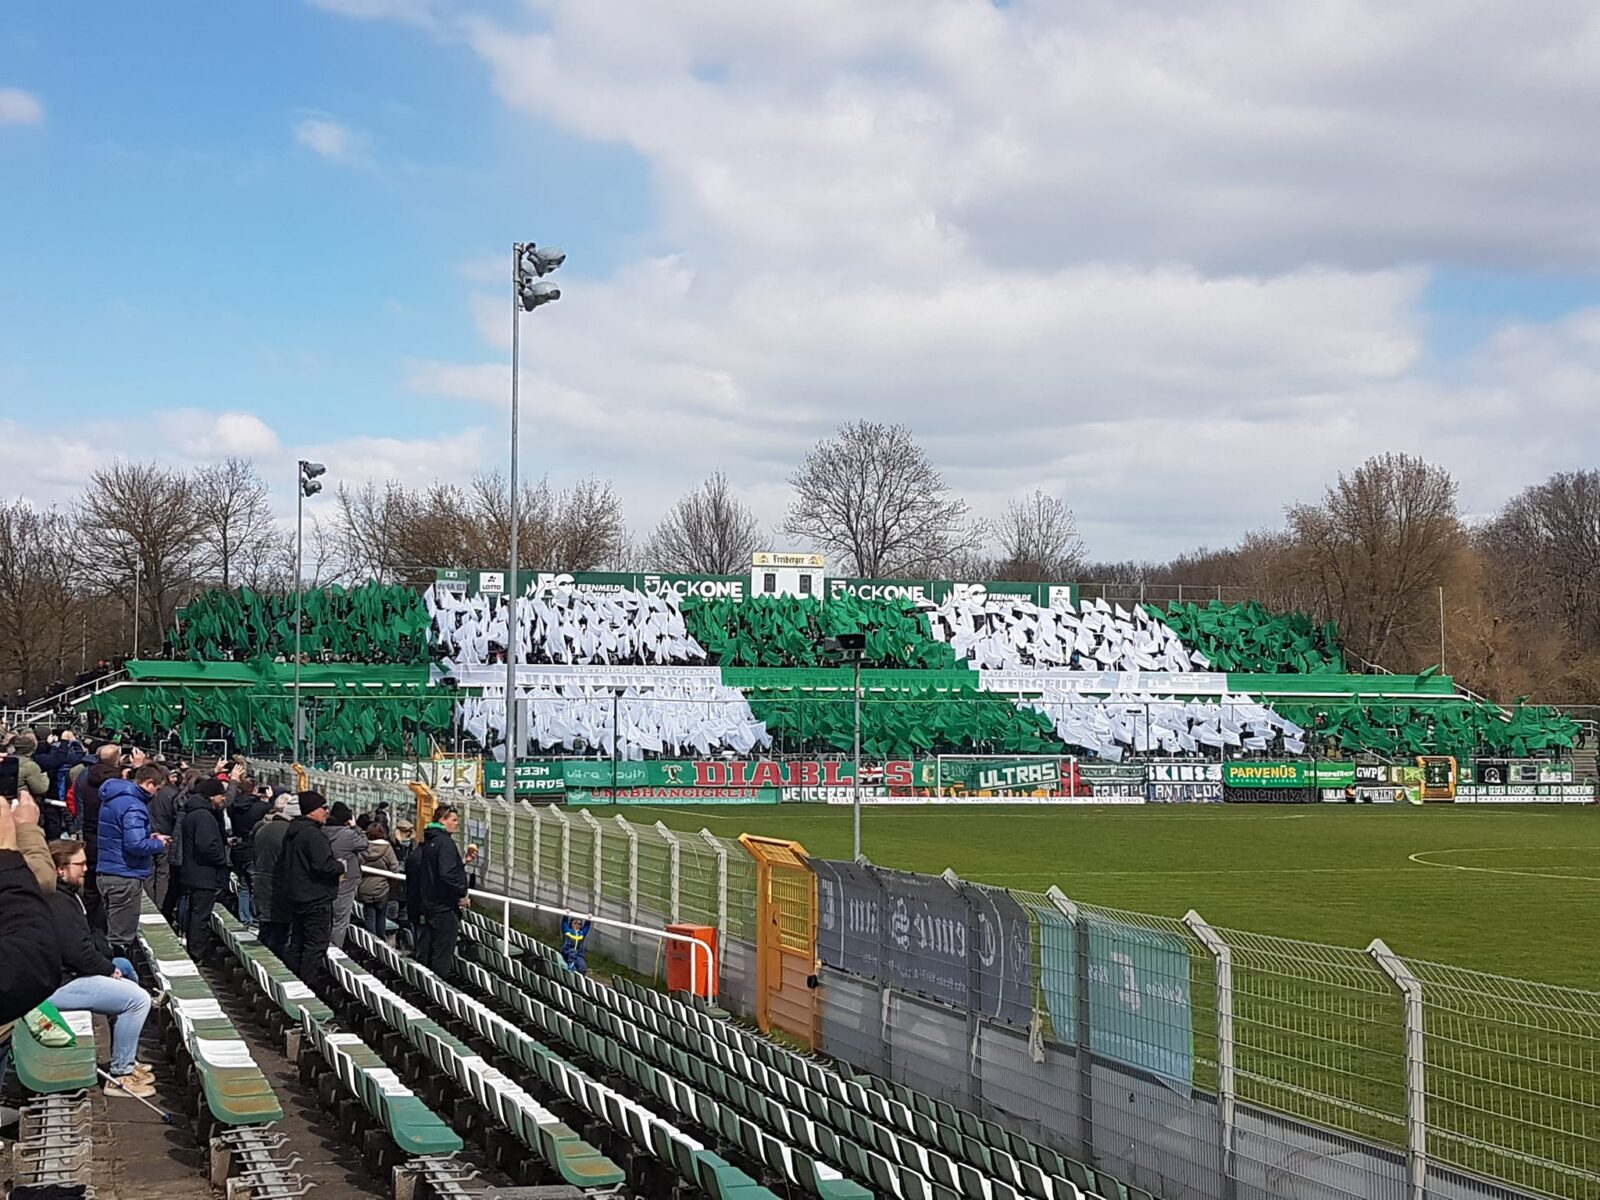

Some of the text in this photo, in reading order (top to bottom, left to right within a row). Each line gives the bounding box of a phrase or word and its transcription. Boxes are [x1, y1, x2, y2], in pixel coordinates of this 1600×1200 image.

[988, 593, 1032, 602] FERNMELDE
[331, 761, 400, 784] Alcatraz
[692, 760, 914, 787] DIABLS
[979, 762, 1056, 788] ULTRAS
[1145, 765, 1205, 781] SKINS
[1230, 765, 1297, 779] PARVENÜS
[489, 778, 565, 789] BATARDS
[1154, 784, 1188, 799] ANTI
